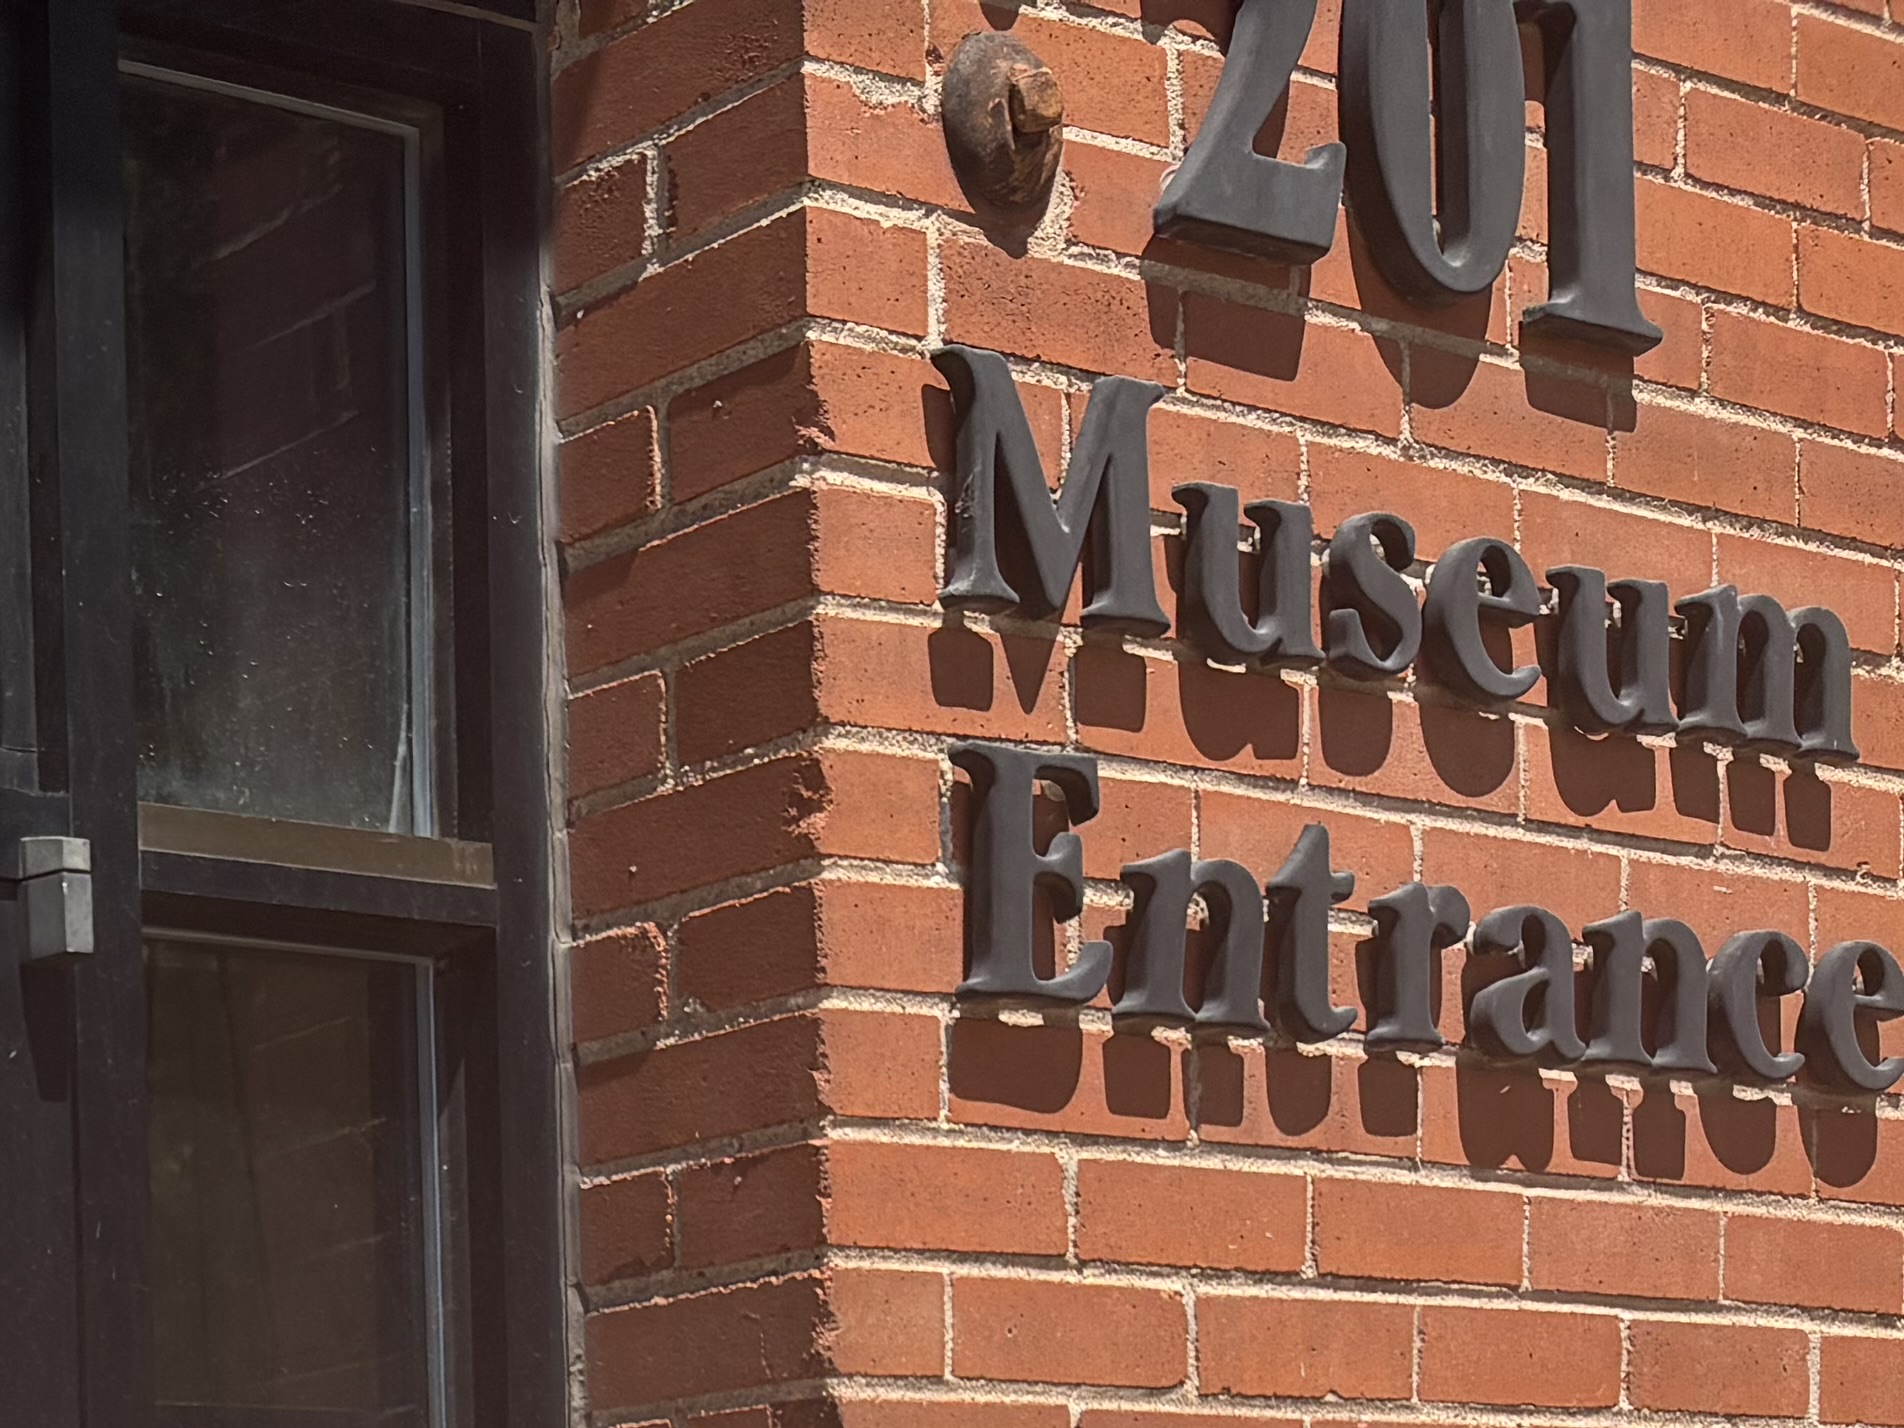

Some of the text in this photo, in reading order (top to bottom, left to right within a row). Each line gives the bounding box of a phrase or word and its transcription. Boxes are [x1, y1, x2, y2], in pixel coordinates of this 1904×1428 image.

[1151, 0, 1664, 357] 201
[929, 344, 1861, 762] Museum
[947, 740, 1904, 1092] Entrance
